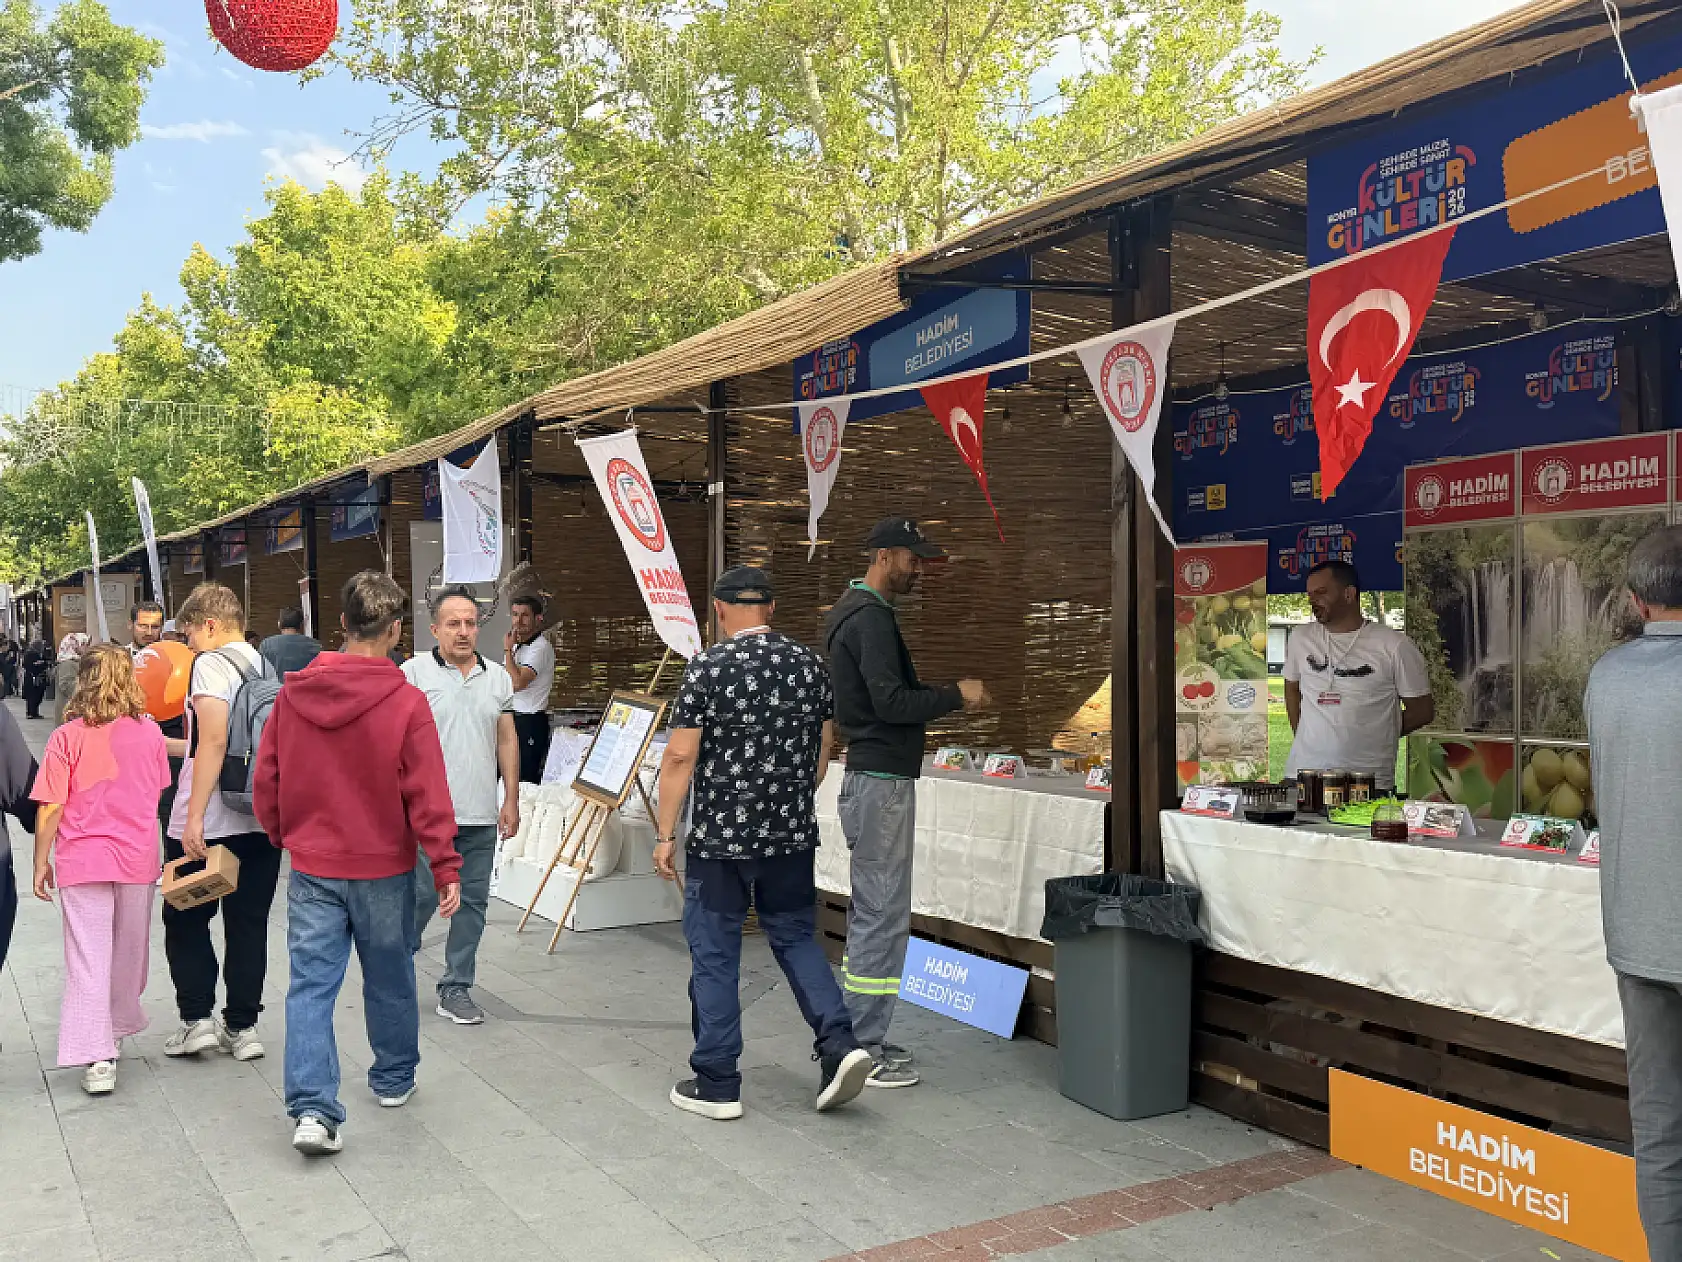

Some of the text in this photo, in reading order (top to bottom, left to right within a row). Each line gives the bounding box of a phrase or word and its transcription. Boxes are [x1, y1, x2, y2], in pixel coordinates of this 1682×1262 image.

[1358, 158, 1466, 214] KÜLTÜR
[1327, 193, 1446, 255] GÜNLERİ
[916, 313, 959, 348] HADİM
[905, 325, 973, 376] BELEDİYESİ
[1449, 472, 1510, 497] HADİM
[1580, 456, 1659, 481] HADİM
[1580, 474, 1659, 494] BELEDİYESİ
[1449, 489, 1510, 508] BELEDİYESİ
[924, 956, 969, 984] HADİM
[905, 975, 976, 1012] BELEDİYESİ
[1437, 1120, 1536, 1176] HADİM
[1409, 1147, 1569, 1224] BELEDİYESİ
